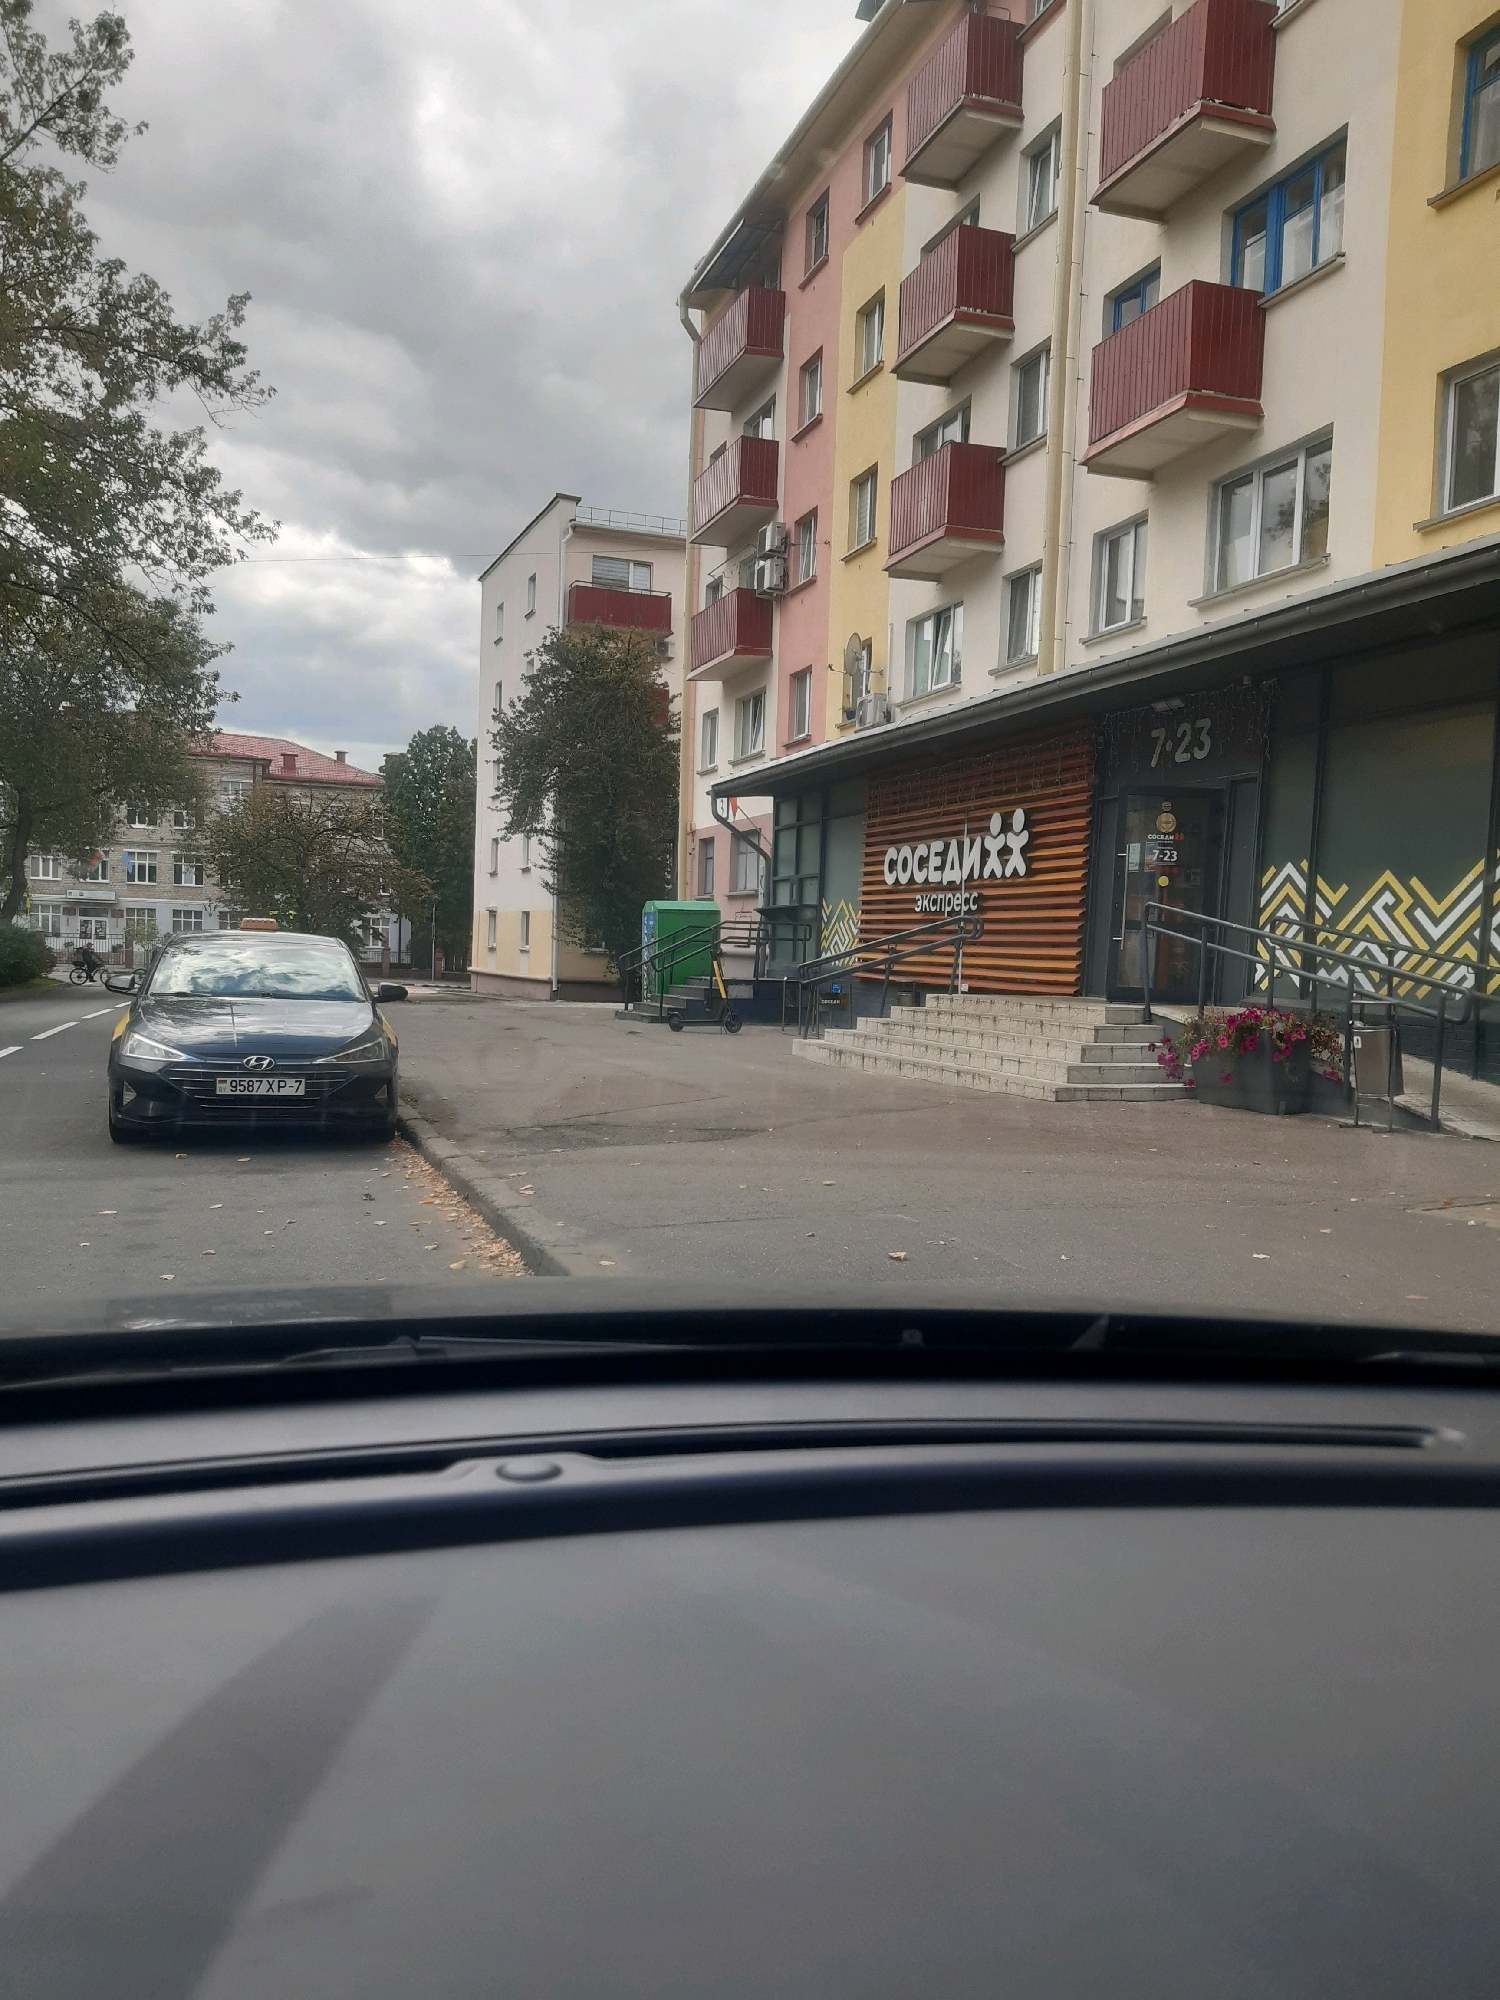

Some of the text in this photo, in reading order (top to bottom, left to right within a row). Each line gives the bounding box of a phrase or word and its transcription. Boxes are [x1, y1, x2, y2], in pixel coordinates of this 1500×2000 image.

[884, 835, 982, 885] СОСЕДИ
[1152, 849, 1178, 862] 7-23
[914, 892, 979, 918] экспресс
[229, 1079, 263, 1093] 9587
